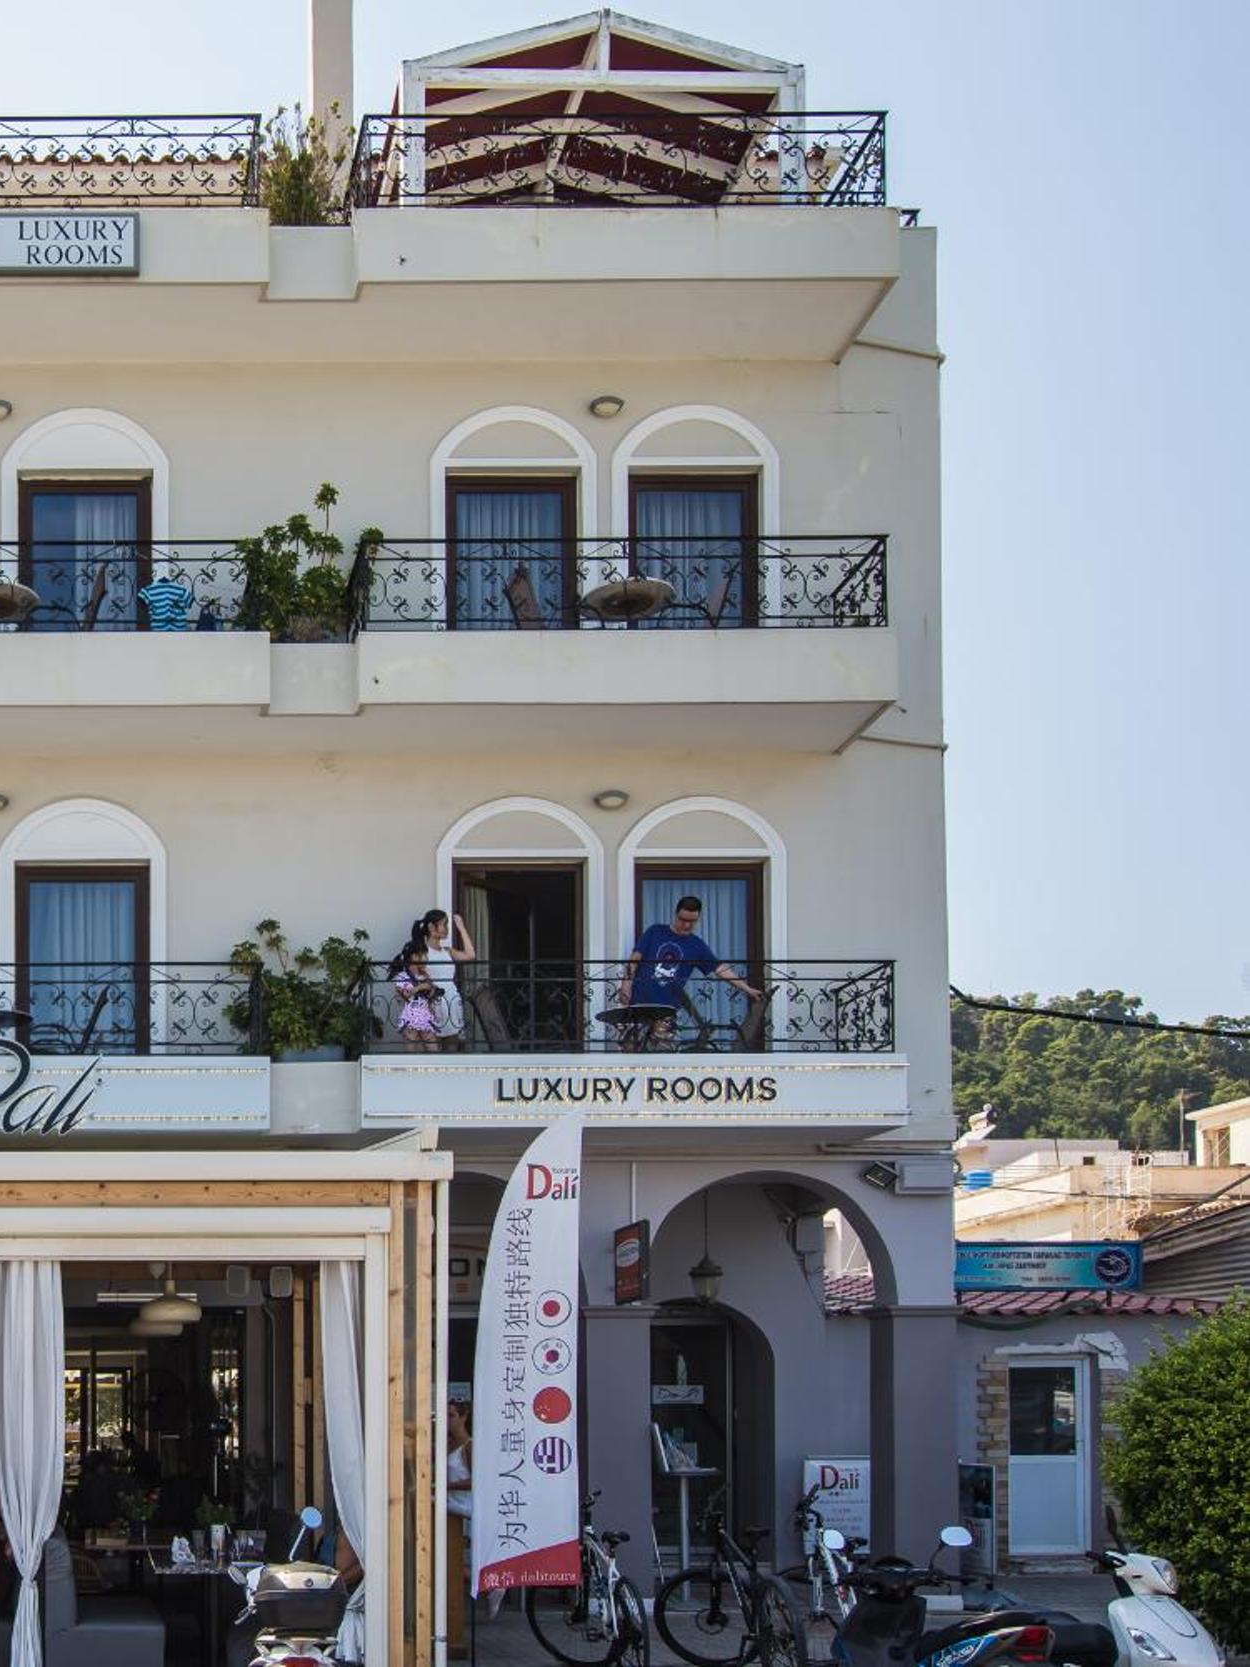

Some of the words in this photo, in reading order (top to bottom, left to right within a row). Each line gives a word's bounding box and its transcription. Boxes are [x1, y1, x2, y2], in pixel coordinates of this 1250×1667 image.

[17, 219, 130, 242] LUXURY
[25, 244, 124, 266] ROOMS
[495, 1076, 637, 1103] LUXURY
[646, 1076, 780, 1103] ROOMS
[526, 1162, 580, 1201] Dalí
[497, 1206, 534, 1550] 为华人量身定制独特路线
[819, 1465, 860, 1490] Dalí
